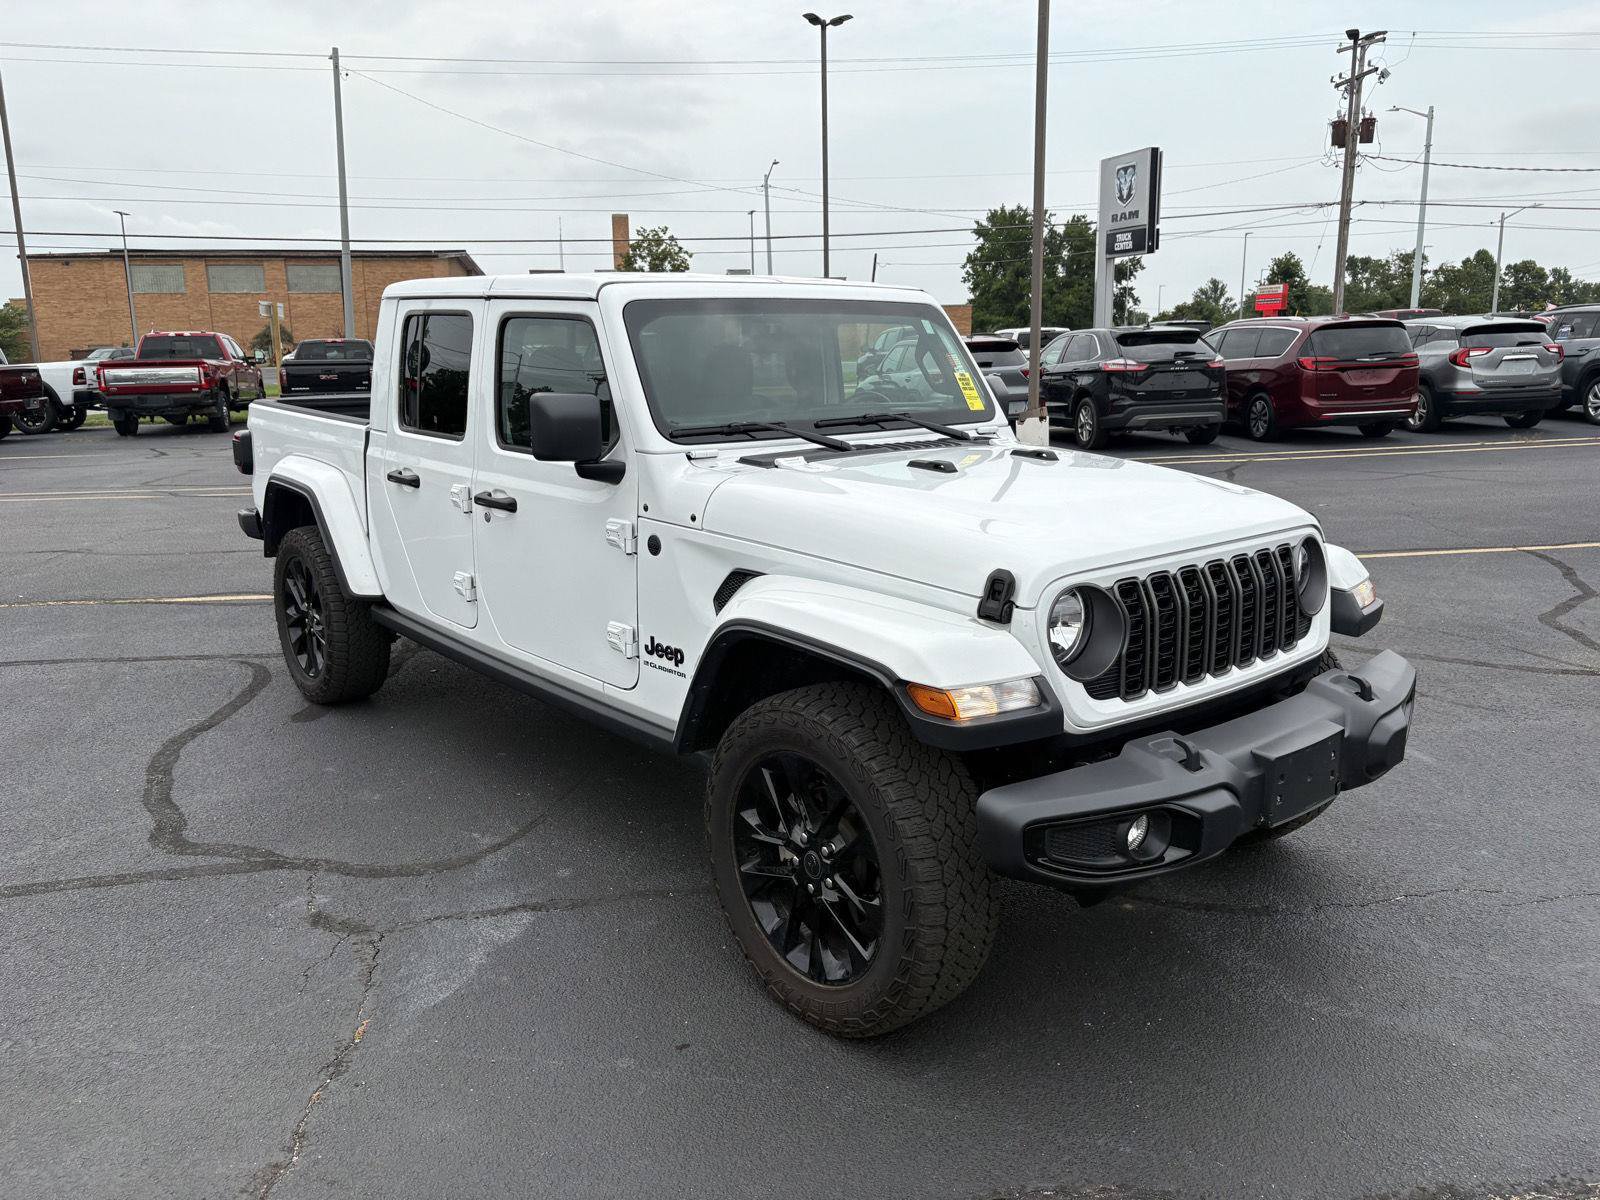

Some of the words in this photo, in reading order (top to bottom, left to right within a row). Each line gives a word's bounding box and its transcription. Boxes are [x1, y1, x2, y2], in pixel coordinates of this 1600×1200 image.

[1111, 209, 1140, 223] RAM
[1115, 232, 1132, 243] TRUCK
[1114, 240, 1133, 251] CENTER
[644, 635, 685, 668] Jeep
[649, 661, 687, 679] GLADIATOR
